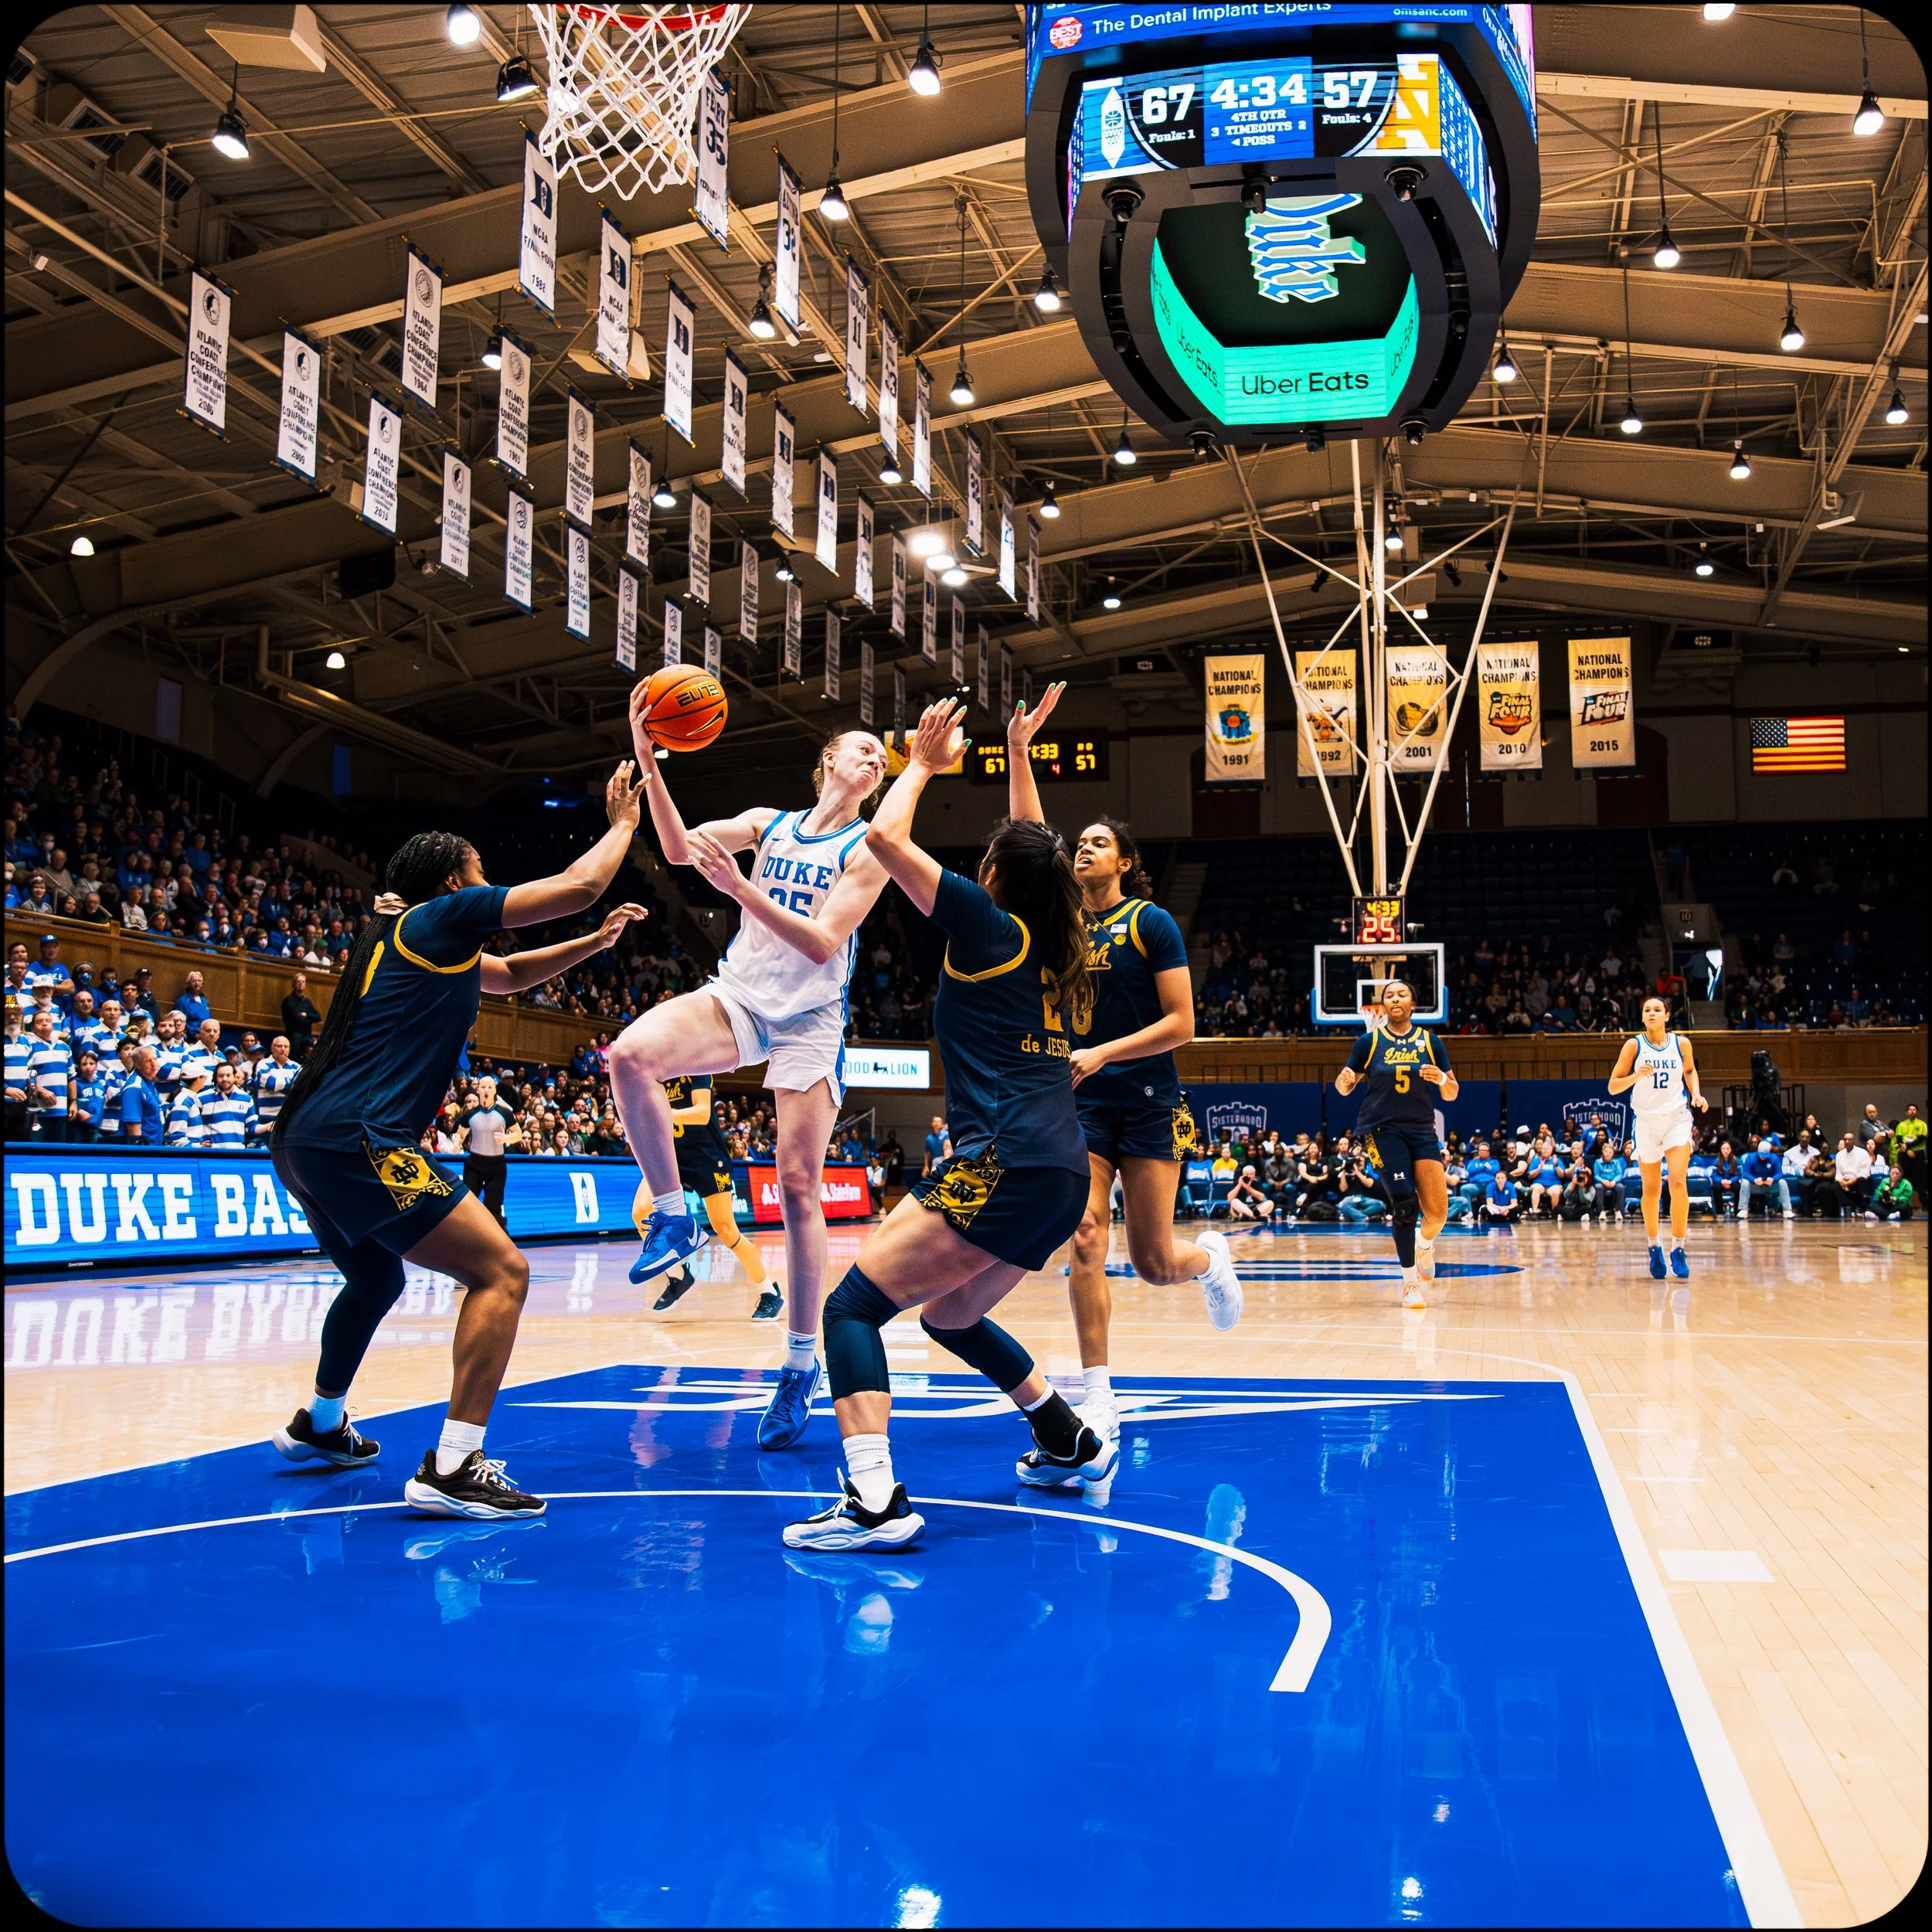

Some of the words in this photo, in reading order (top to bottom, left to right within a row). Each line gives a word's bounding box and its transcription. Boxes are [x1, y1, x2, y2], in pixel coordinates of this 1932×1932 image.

[1092, 20, 1125, 35] The
[1130, 8, 1187, 29] Dental
[1192, 4, 1259, 22] Implant
[1393, 8, 1468, 16] omsanc.com
[1049, 23, 1083, 40] BEST
[1210, 73, 1307, 110] 4:34
[1323, 71, 1378, 109] 57
[1142, 83, 1196, 124] 67
[1230, 111, 1258, 122] 4TH
[1260, 109, 1287, 122] QTR
[1321, 114, 1361, 124] Fouls:
[1362, 113, 1372, 123] 4
[1148, 131, 1186, 145] Fouls:
[1187, 129, 1196, 139] 1
[1211, 128, 1219, 137] 3
[1225, 121, 1293, 136] TIMEOUTS
[1298, 121, 1306, 131] 2
[706, 116, 726, 166] 35
[1242, 134, 1276, 147] POSS
[197, 329, 223, 355] ATLANTIC
[1242, 375, 1302, 396] Uber
[1308, 371, 1369, 393] Eats
[1577, 653, 1623, 666] NATIONAL
[1213, 670, 1257, 682] NATIONAL
[1573, 666, 1629, 680] CHAMPIONS
[1208, 683, 1261, 696] CHAMPIONS
[1303, 679, 1353, 690] HAMPIONS
[675, 684, 719, 707] ELITE
[1501, 695, 1531, 706] FINAL
[1596, 693, 1626, 706] FINAL
[1406, 746, 1432, 757] 2001
[1498, 743, 1526, 754] 2010
[1590, 740, 1619, 752] 2015
[985, 758, 1005, 774] 67
[1076, 754, 1095, 770] 57
[1223, 755, 1249, 765] 1991
[761, 855, 833, 891] DUKE
[1366, 901, 1400, 917] 4:33
[1362, 917, 1395, 943] 25
[1021, 1033, 1040, 1053] de
[1046, 1036, 1071, 1059] JESUS
[1383, 1046, 1420, 1064] Irish
[845, 1061, 869, 1074] OOD
[891, 1063, 917, 1075] LION
[1395, 1065, 1411, 1094] 5
[1652, 1072, 1669, 1089] 12
[1212, 1114, 1261, 1128] SISTERHOOD
[10, 1172, 198, 1247] DUKE
